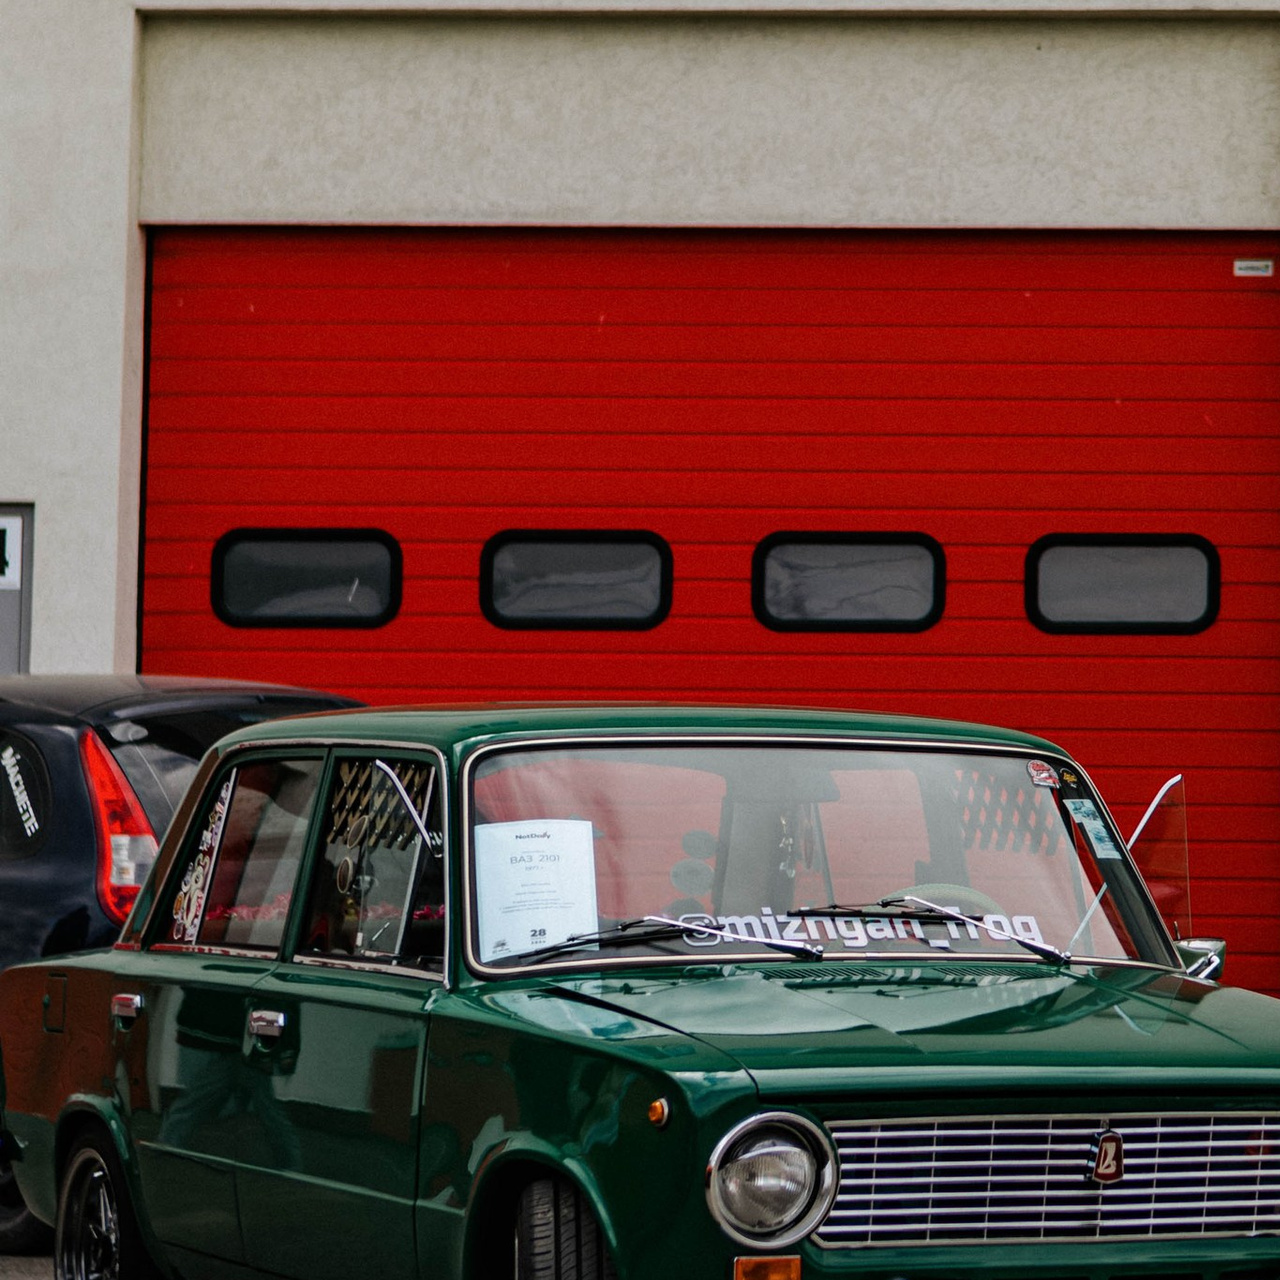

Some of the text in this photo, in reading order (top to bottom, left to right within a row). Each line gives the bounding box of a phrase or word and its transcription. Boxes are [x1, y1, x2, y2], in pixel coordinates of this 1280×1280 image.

[510, 854, 560, 865] ВАЗ 2101
[530, 928, 547, 938] 28
